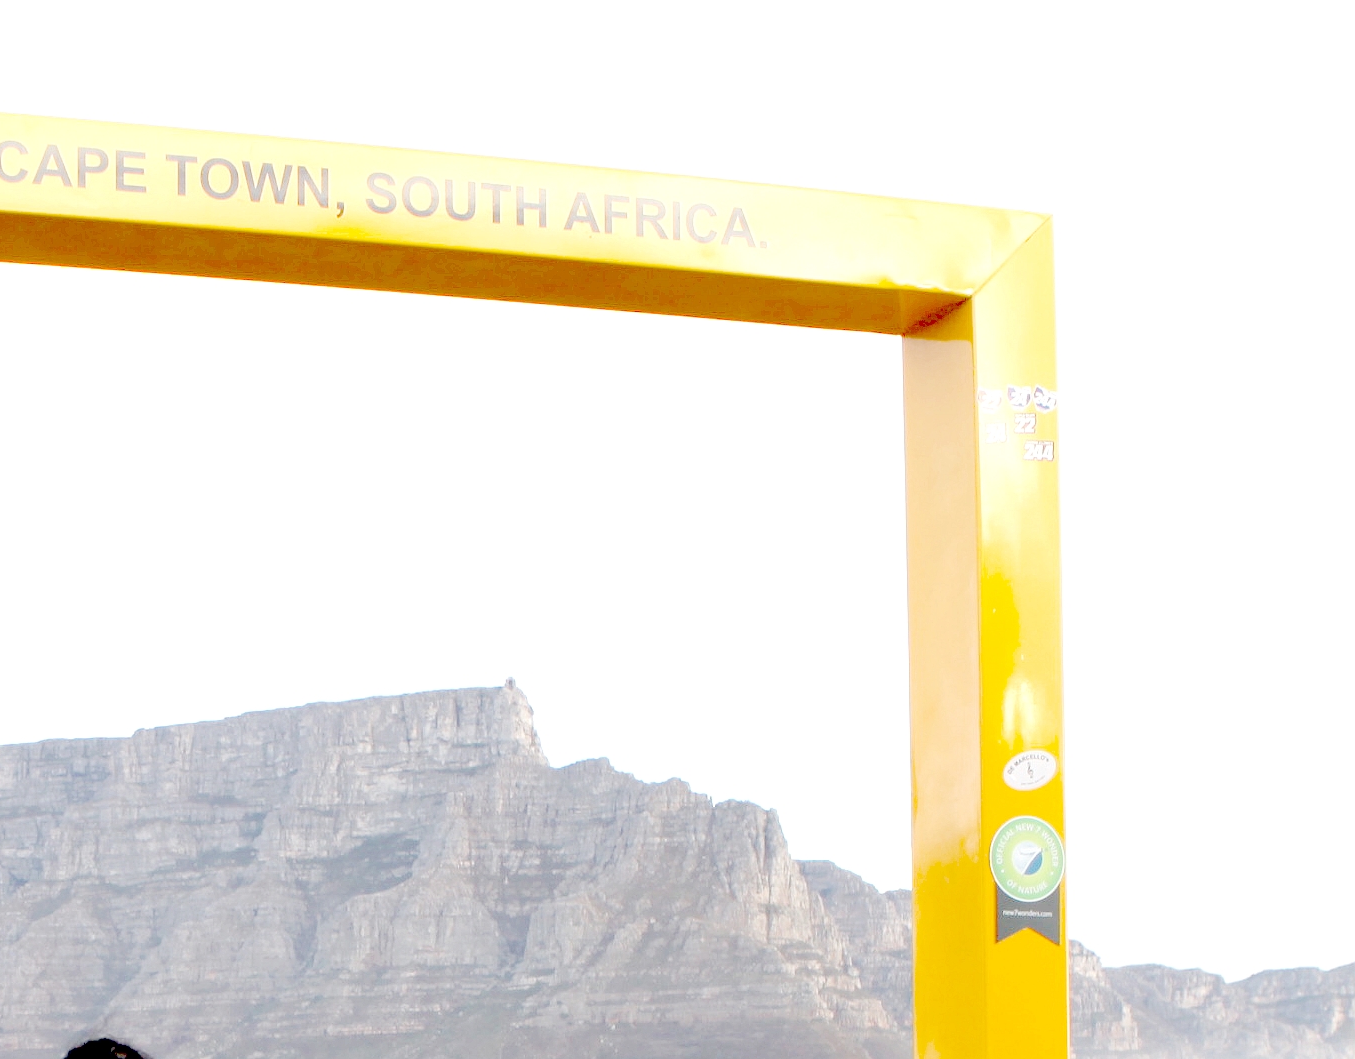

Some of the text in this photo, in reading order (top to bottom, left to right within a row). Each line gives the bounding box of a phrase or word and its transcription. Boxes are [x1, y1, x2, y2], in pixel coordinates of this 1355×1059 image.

[165, 154, 345, 218] TOWN,
[365, 172, 547, 229] SOUTH
[563, 191, 769, 249] AFRICA.
[996, 829, 1014, 864] OFFICIAL
[1015, 823, 1034, 832] NEW
[1041, 830, 1059, 867] WONDER
[1006, 879, 1048, 894] OF NATURE
